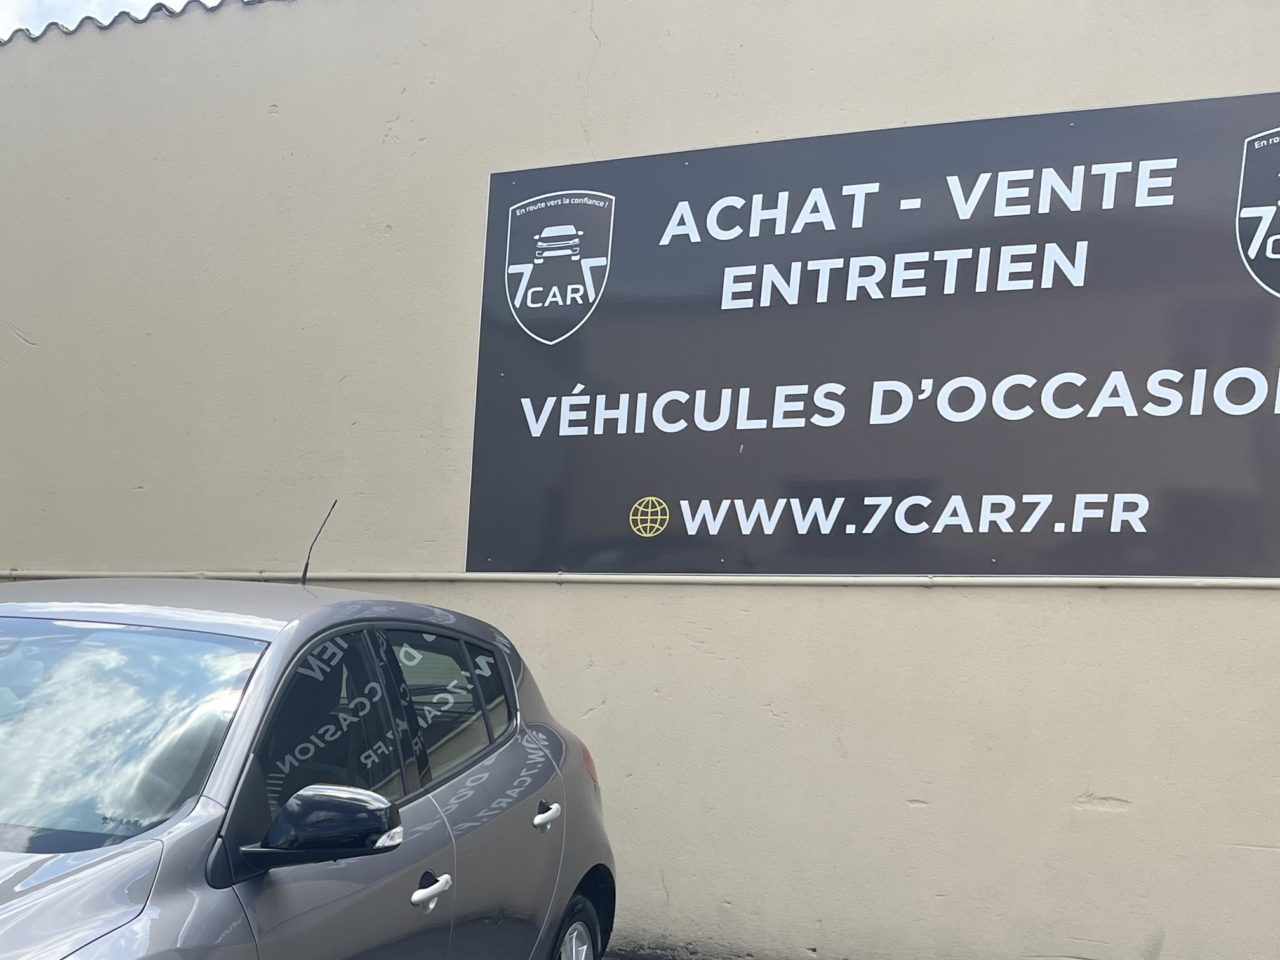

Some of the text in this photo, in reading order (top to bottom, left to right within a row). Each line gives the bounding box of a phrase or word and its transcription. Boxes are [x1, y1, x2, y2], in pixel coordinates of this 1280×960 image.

[659, 182, 880, 246] ACHAT
[945, 158, 1179, 220] VENTE
[720, 240, 1089, 310] ENTRETIEN
[520, 366, 1280, 438] VÉHICULES D’OCCASIO
[680, 493, 1151, 535] WWW.7CAR7.FR
